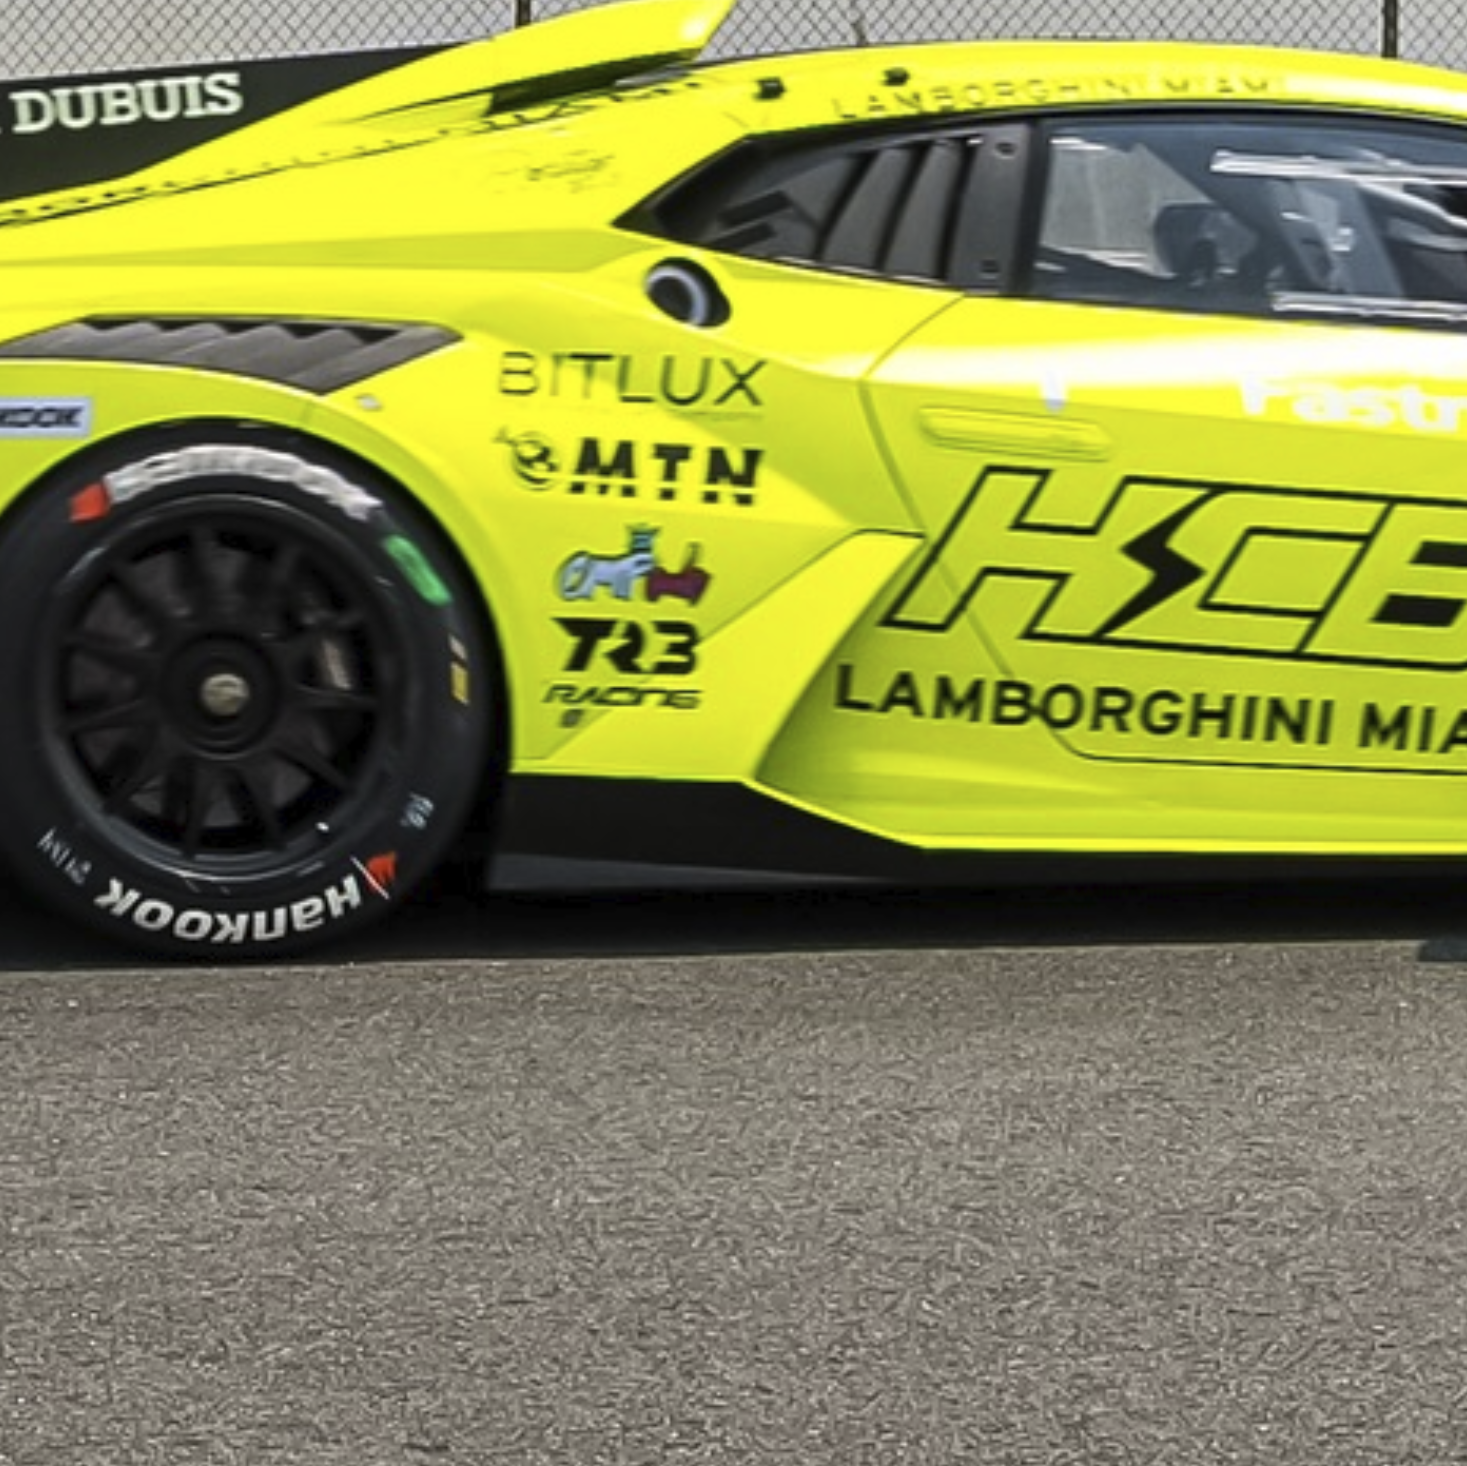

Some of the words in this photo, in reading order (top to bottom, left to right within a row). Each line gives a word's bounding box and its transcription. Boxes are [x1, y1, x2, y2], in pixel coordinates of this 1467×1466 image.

[8, 72, 243, 134] DUBUIS
[499, 352, 767, 406] BITLUX
[567, 437, 765, 506] MTN
[551, 617, 701, 674] TR3
[835, 664, 1335, 745] LAMBORGHINI
